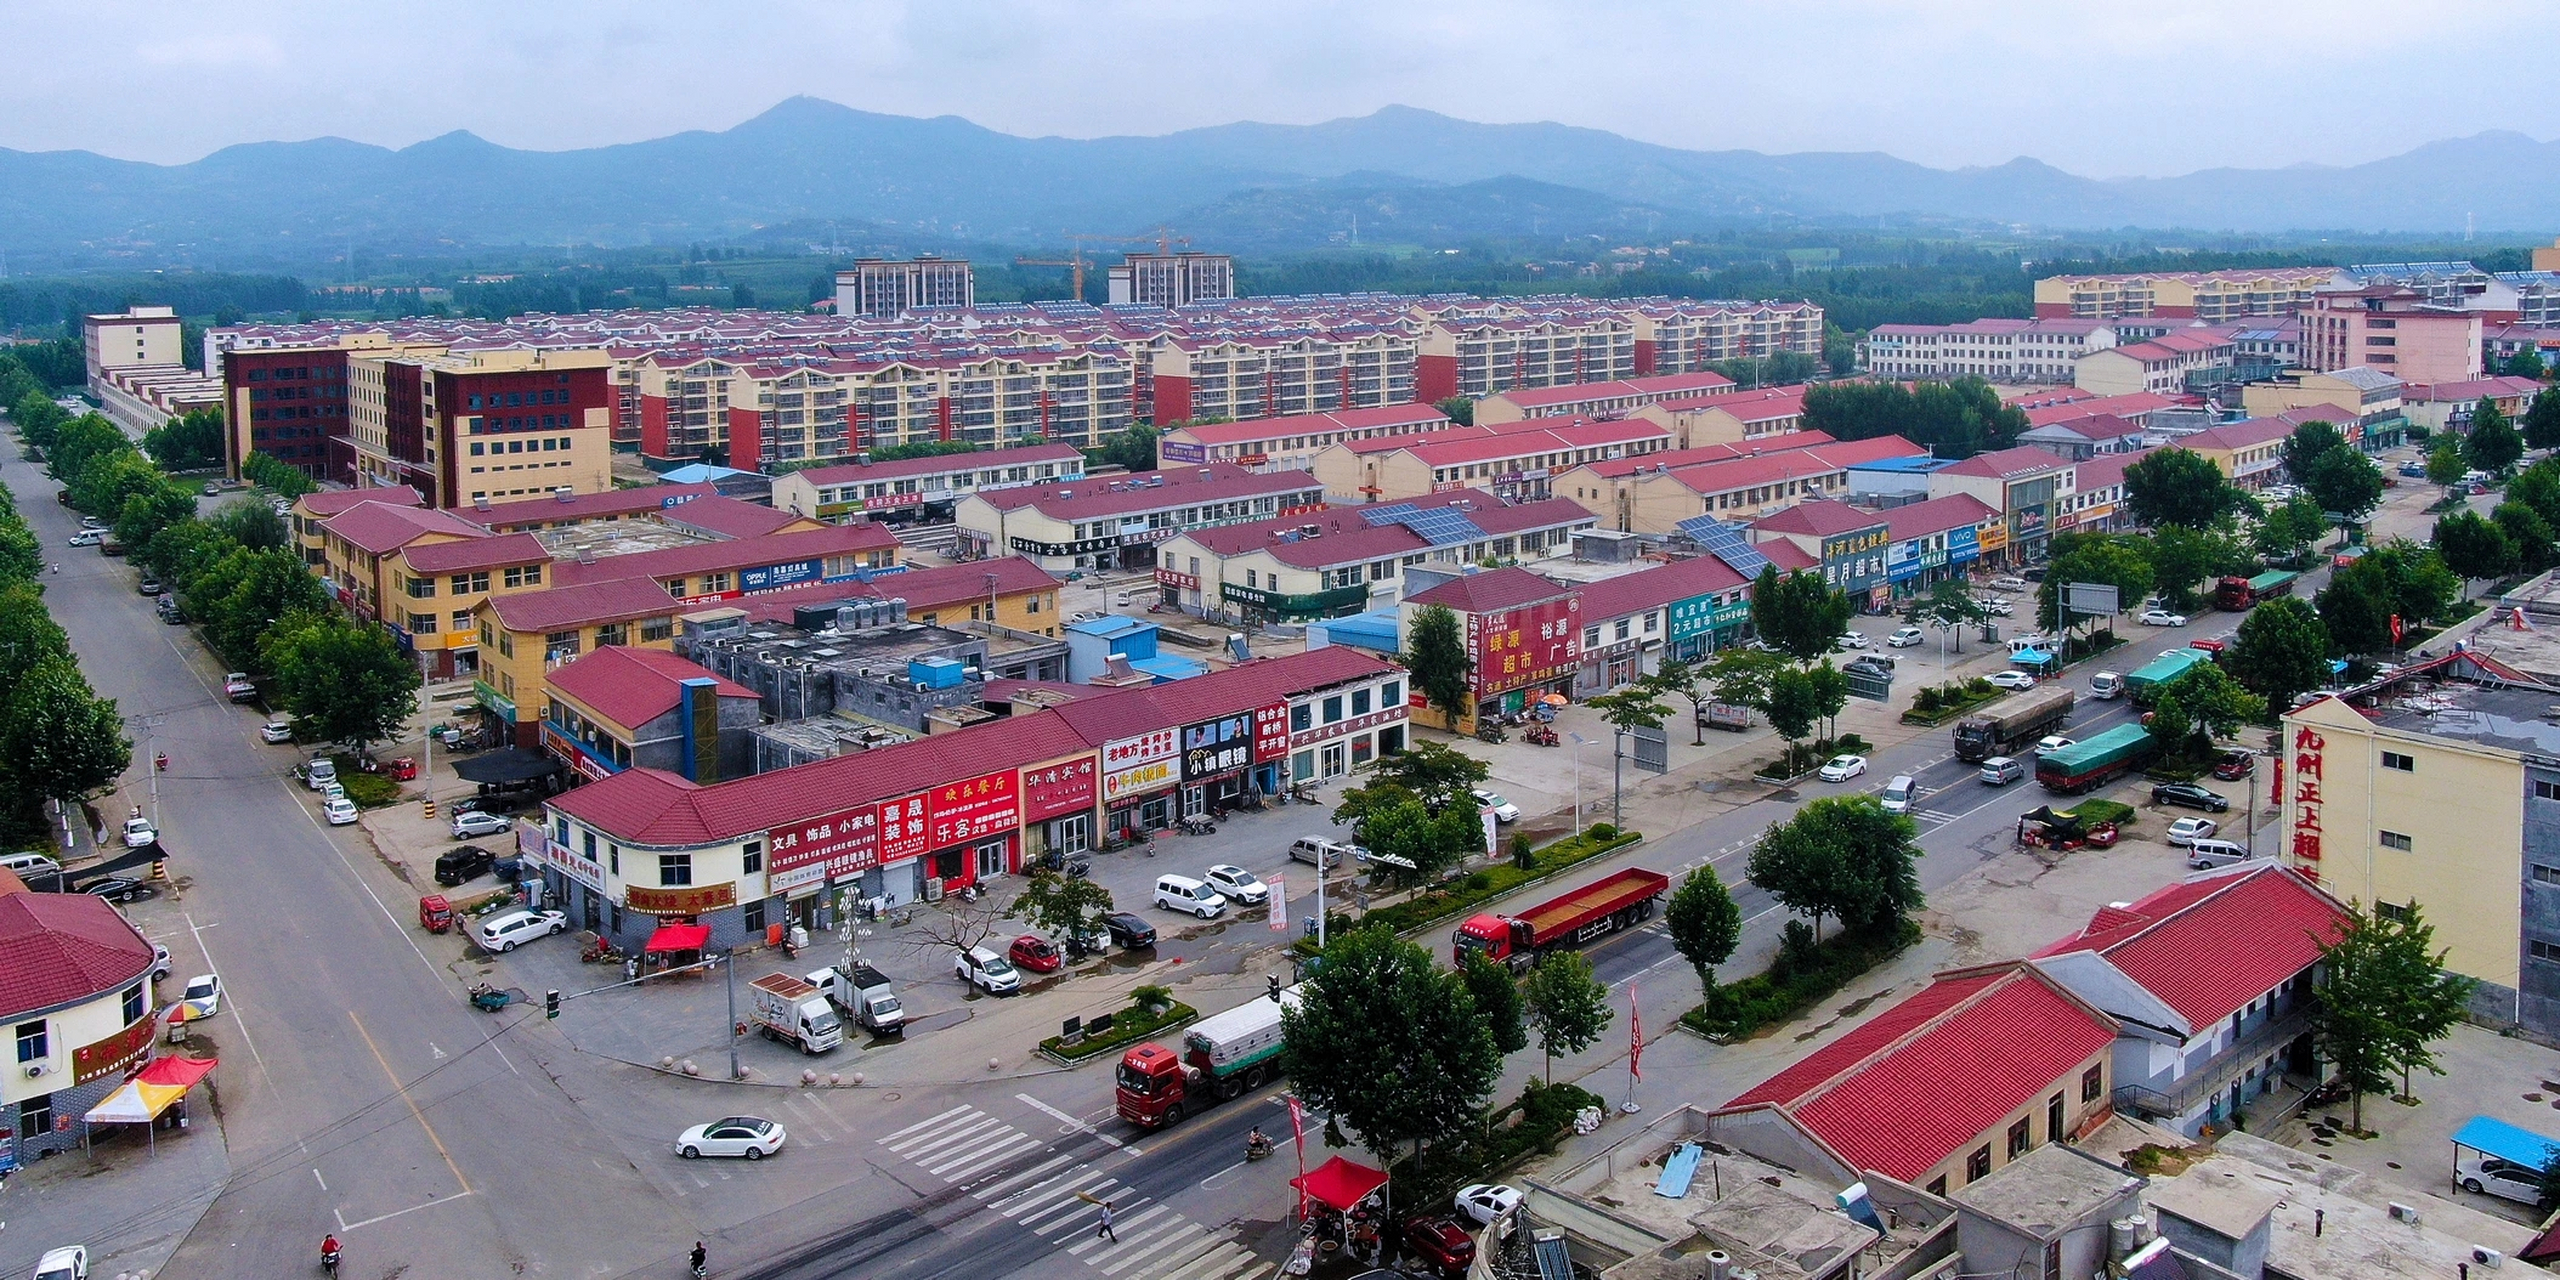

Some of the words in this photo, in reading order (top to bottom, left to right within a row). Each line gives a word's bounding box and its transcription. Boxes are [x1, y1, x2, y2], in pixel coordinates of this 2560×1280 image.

[1826, 529, 1889, 562] 洋河蓝色经典
[746, 571, 767, 580] OPPLE
[1826, 555, 1880, 585] 星月超市
[1489, 629, 1520, 652] 绿源
[1541, 618, 1568, 641] 裕源
[1549, 639, 1577, 661] 广告
[1503, 651, 1532, 674] 超市
[1257, 706, 1286, 722] 铝合金
[1262, 721, 1281, 736] 断桥
[1108, 743, 1139, 762] 老地方
[1258, 736, 1286, 753] 平开窗
[1190, 746, 1247, 776] 小镇眼镜
[1027, 762, 1092, 788] 华清宾馆
[944, 777, 1006, 802] 欢乐餐厅
[771, 833, 798, 852] 文具
[806, 824, 832, 842] 饰品
[838, 813, 876, 833] 小家电
[884, 818, 924, 842] 装饰
[937, 819, 971, 843] 乐客
